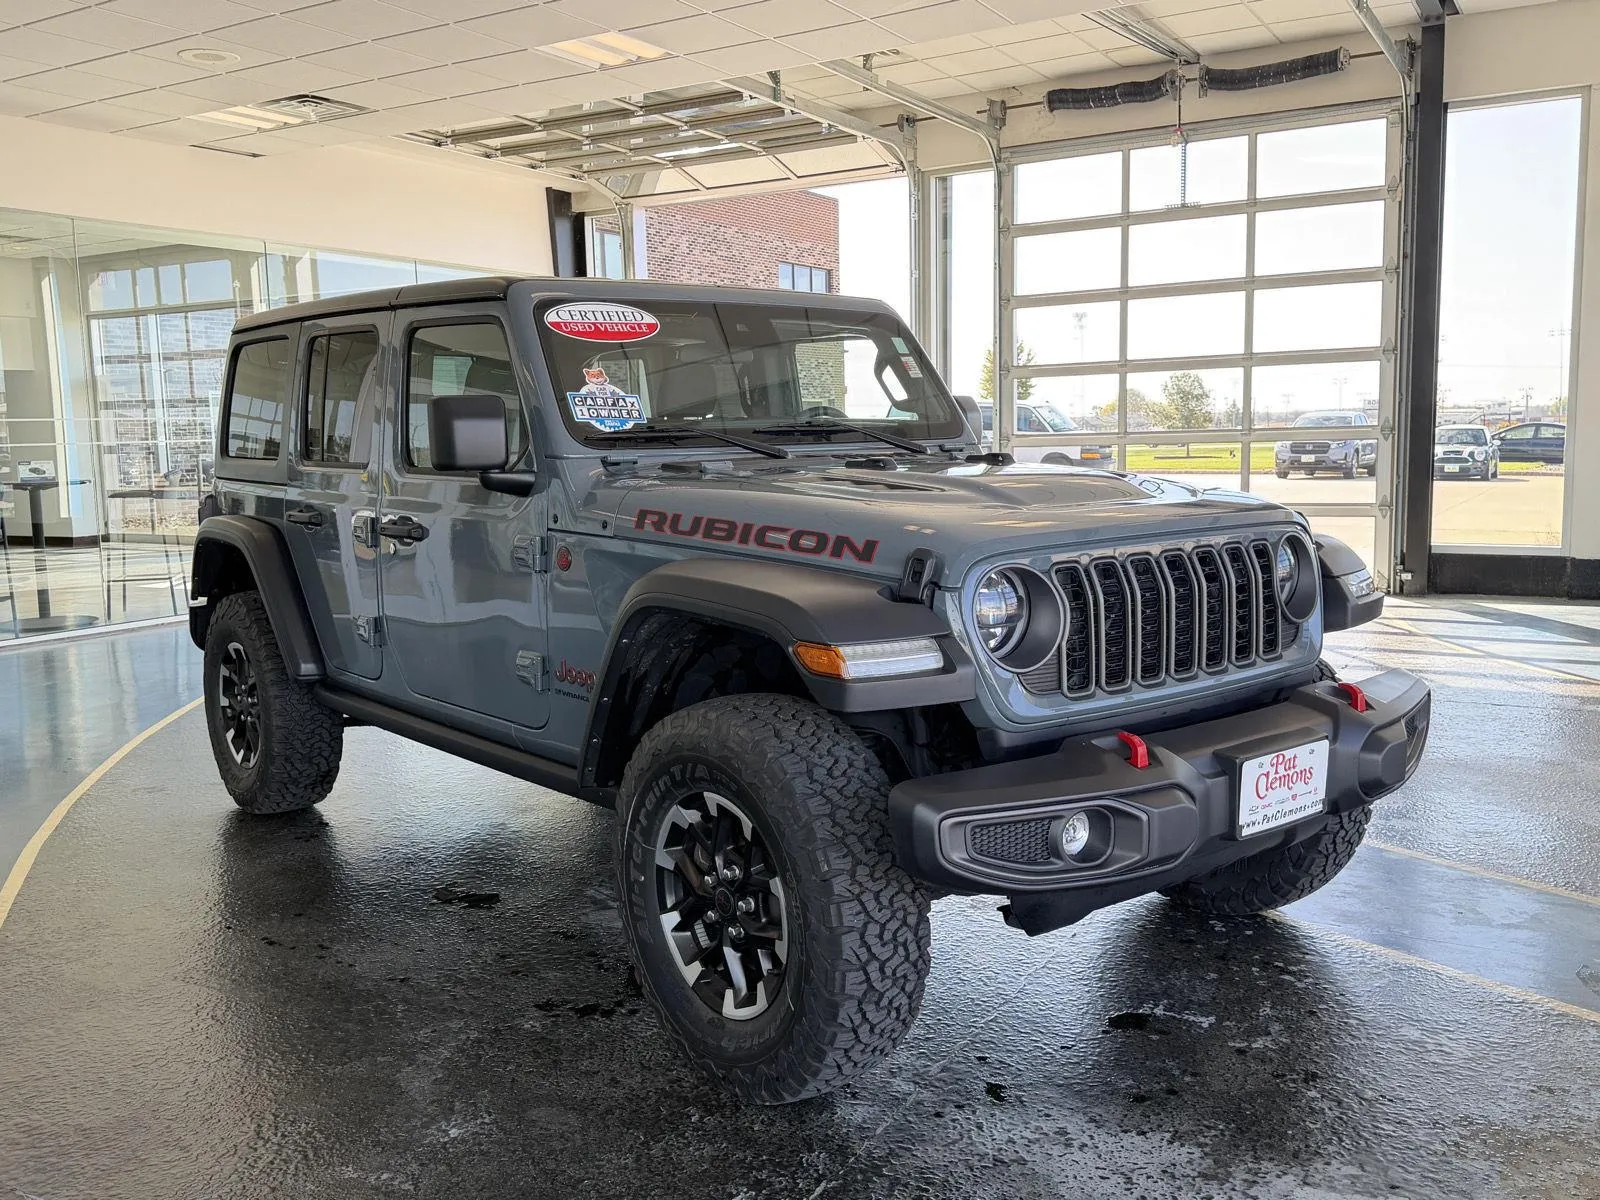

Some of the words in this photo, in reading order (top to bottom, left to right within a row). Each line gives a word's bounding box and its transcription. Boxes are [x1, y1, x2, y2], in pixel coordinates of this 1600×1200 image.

[555, 309, 644, 322] CERTIFIED
[561, 323, 595, 332] USED
[596, 324, 650, 333] VEHICLE
[574, 397, 637, 409] CARFAX
[579, 408, 586, 417] 1
[588, 408, 641, 419] OWNER
[633, 508, 879, 564] RUBICON
[553, 656, 597, 693] Jeep
[1269, 752, 1298, 774] Pat
[1255, 766, 1314, 799] Clemons
